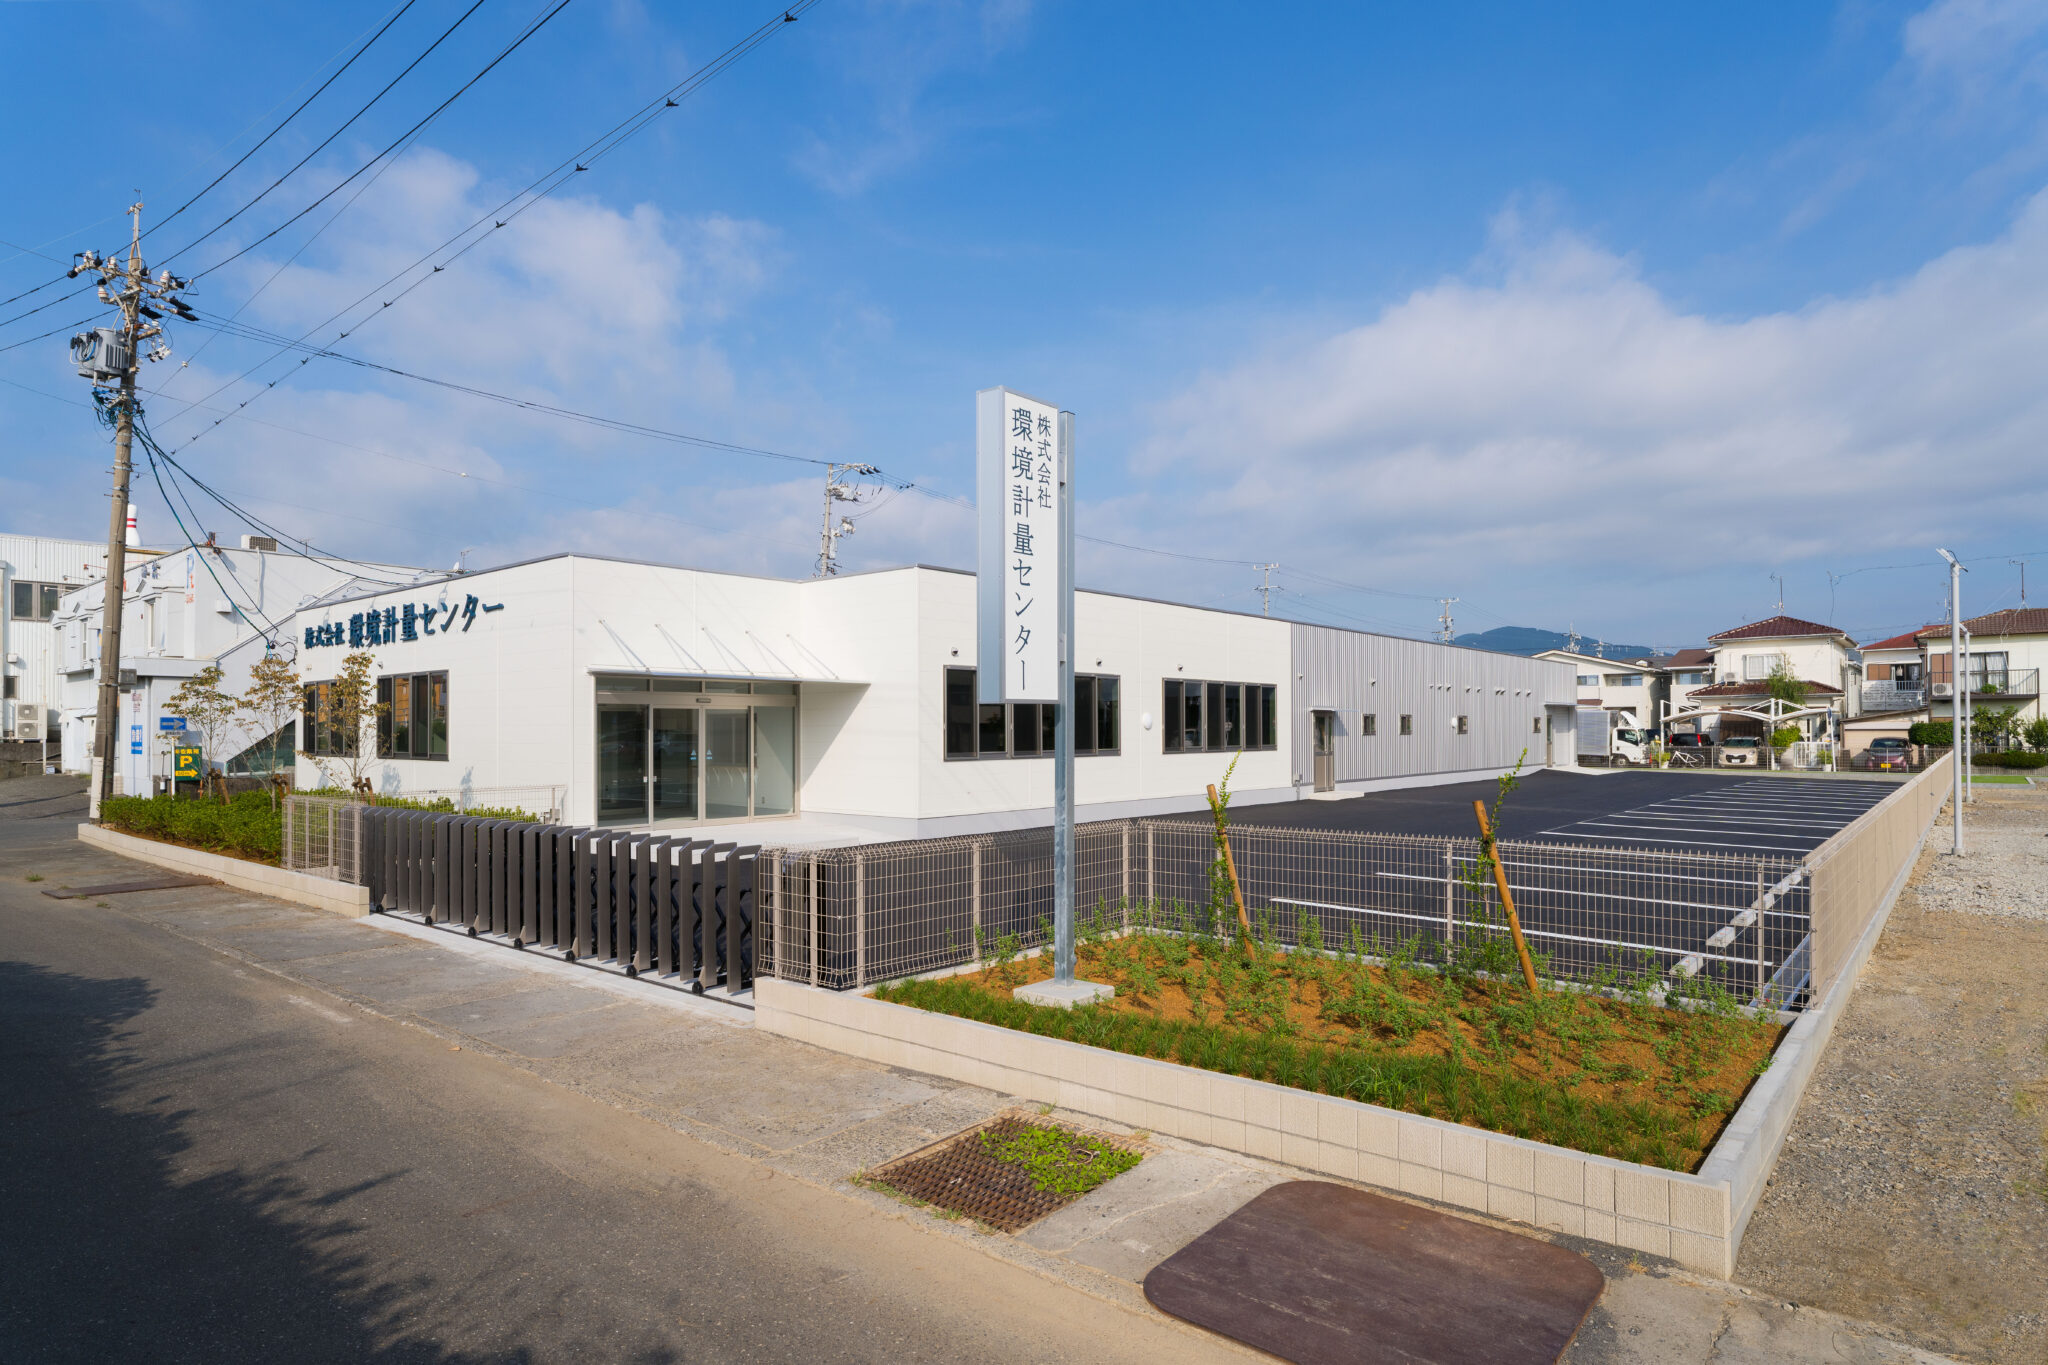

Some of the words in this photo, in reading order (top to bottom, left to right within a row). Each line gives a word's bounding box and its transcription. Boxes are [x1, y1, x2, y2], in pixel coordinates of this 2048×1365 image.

[1037, 412, 1052, 509] 株式会社
[1011, 407, 1034, 691] 環境計量センター
[305, 622, 345, 649] 株式会社
[348, 594, 504, 648] 環境計量センター
[180, 755, 193, 768] P
